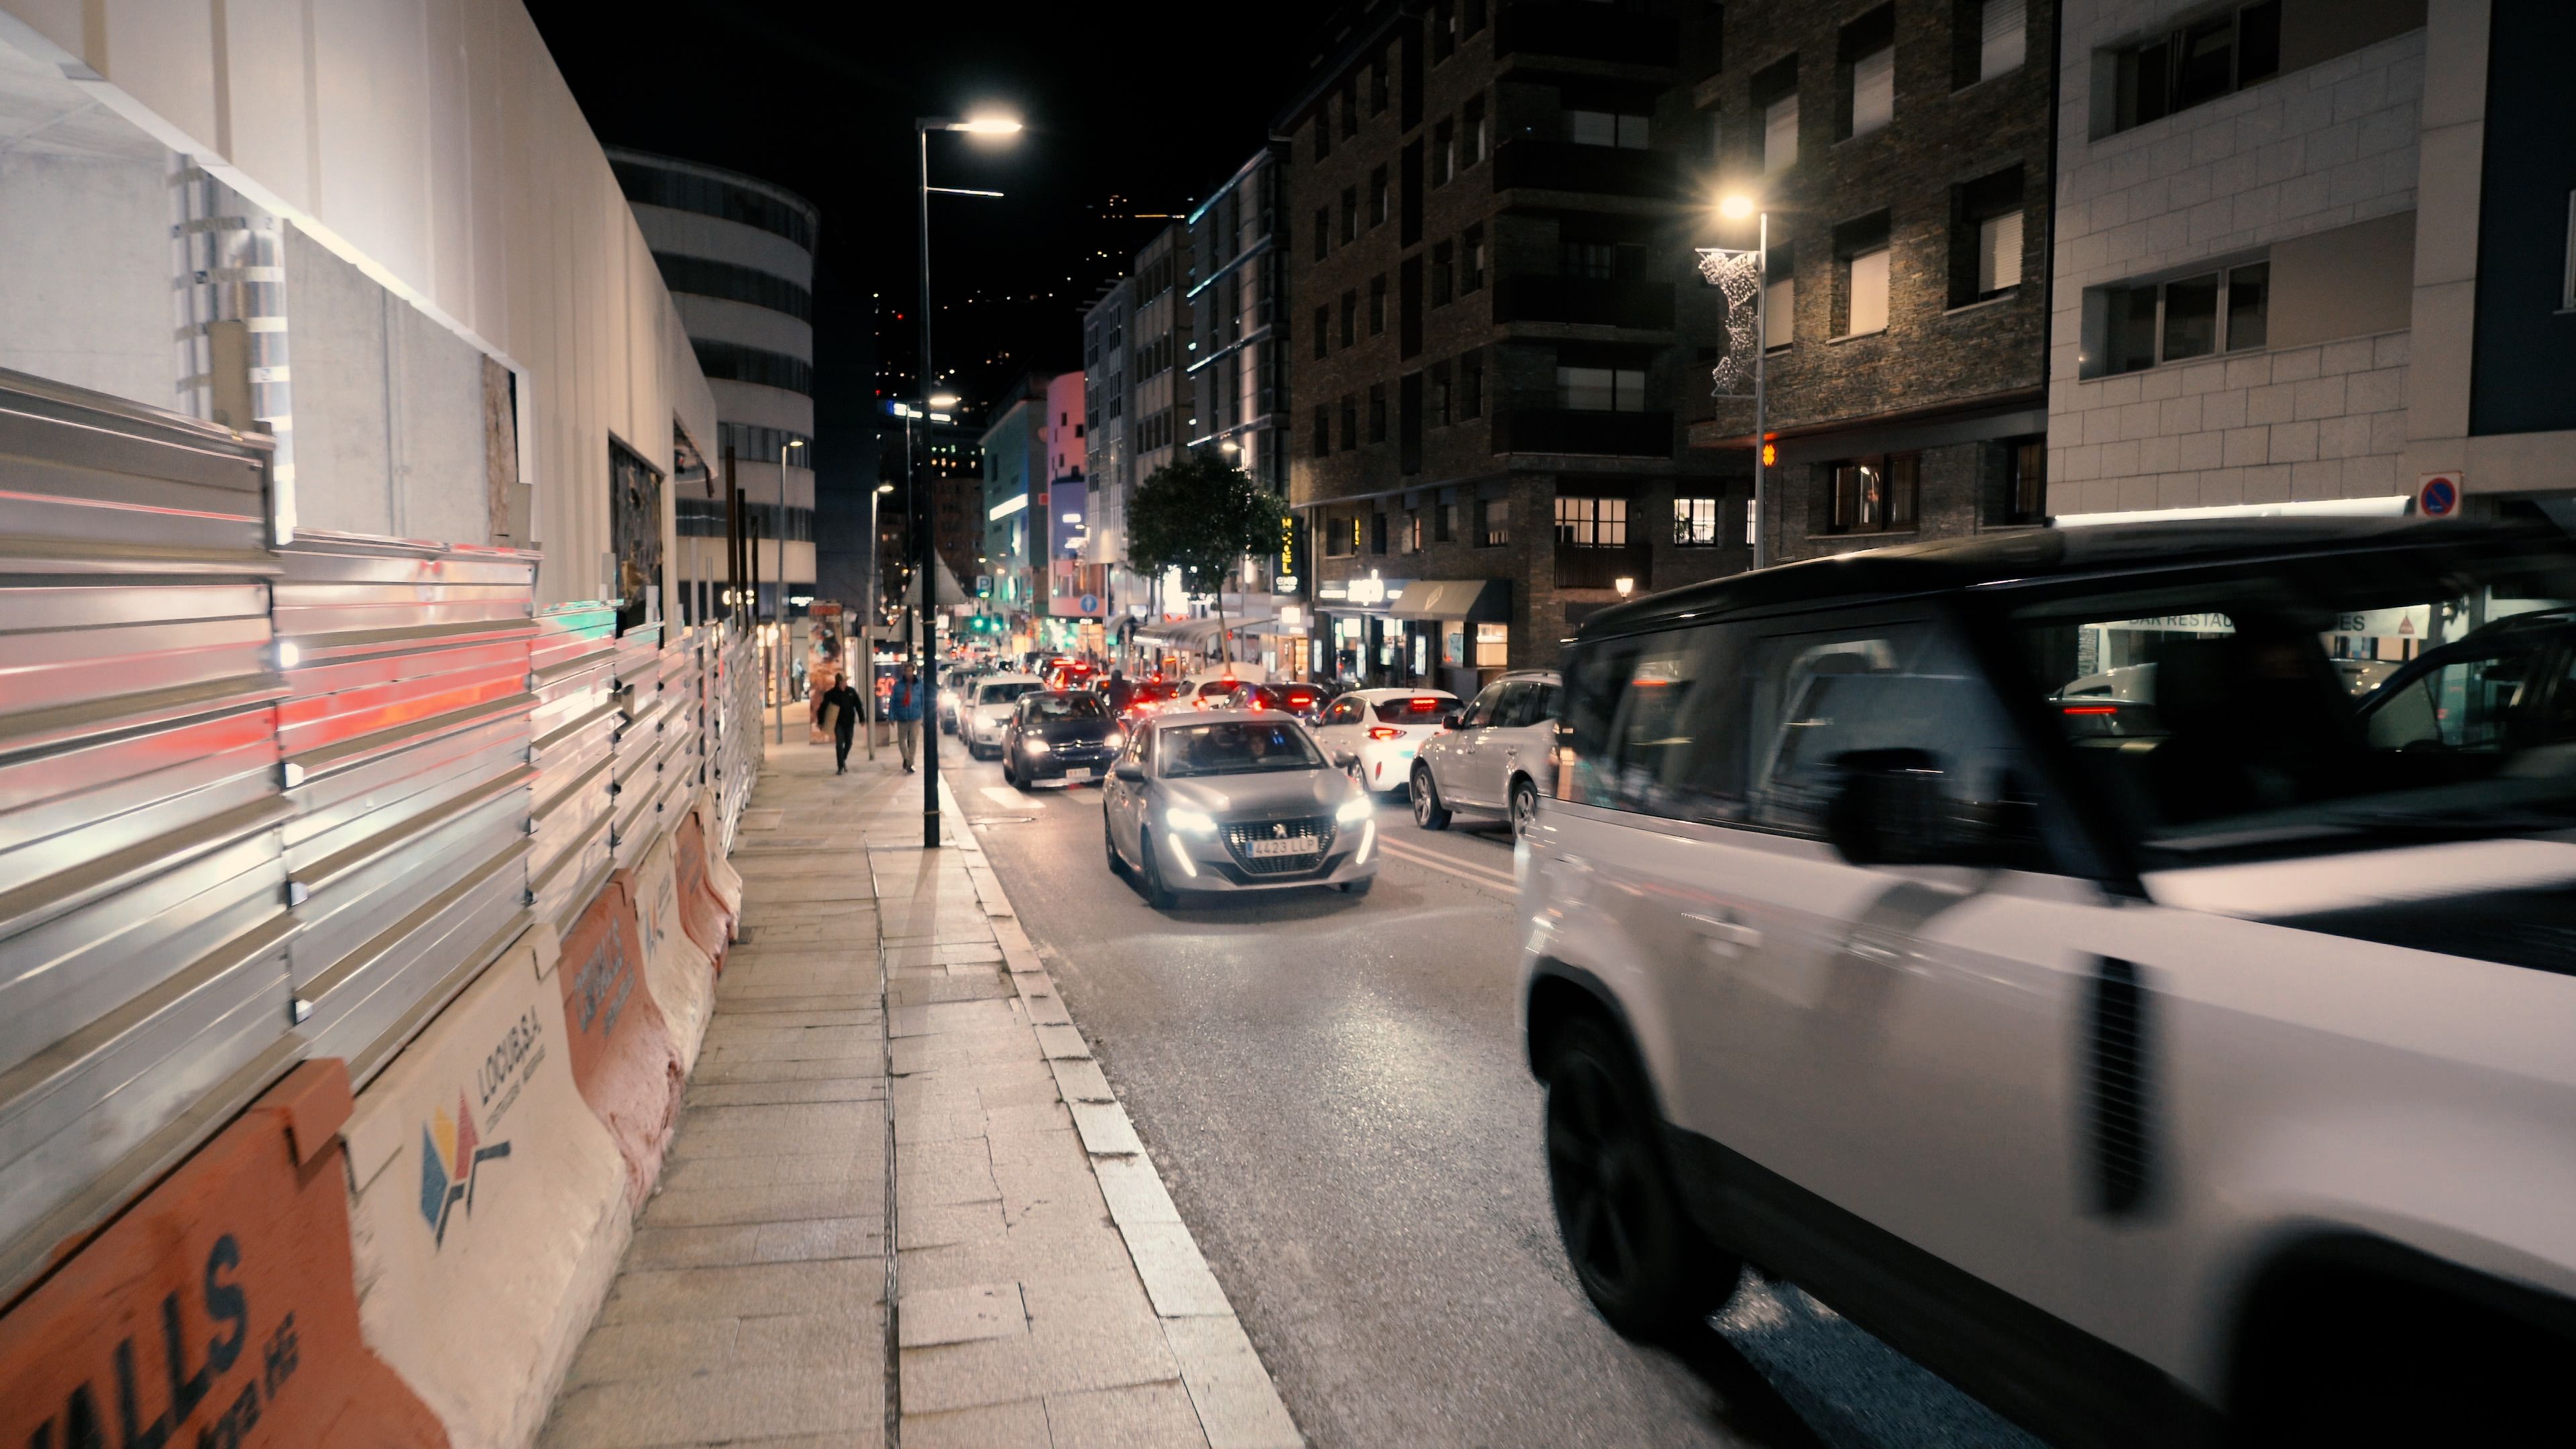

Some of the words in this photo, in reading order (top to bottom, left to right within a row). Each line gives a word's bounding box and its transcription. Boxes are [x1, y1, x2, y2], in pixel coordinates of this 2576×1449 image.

[1256, 841, 1287, 854] 4423
[1291, 839, 1314, 852] LLP
[27, 1232, 250, 1449] ALLS
